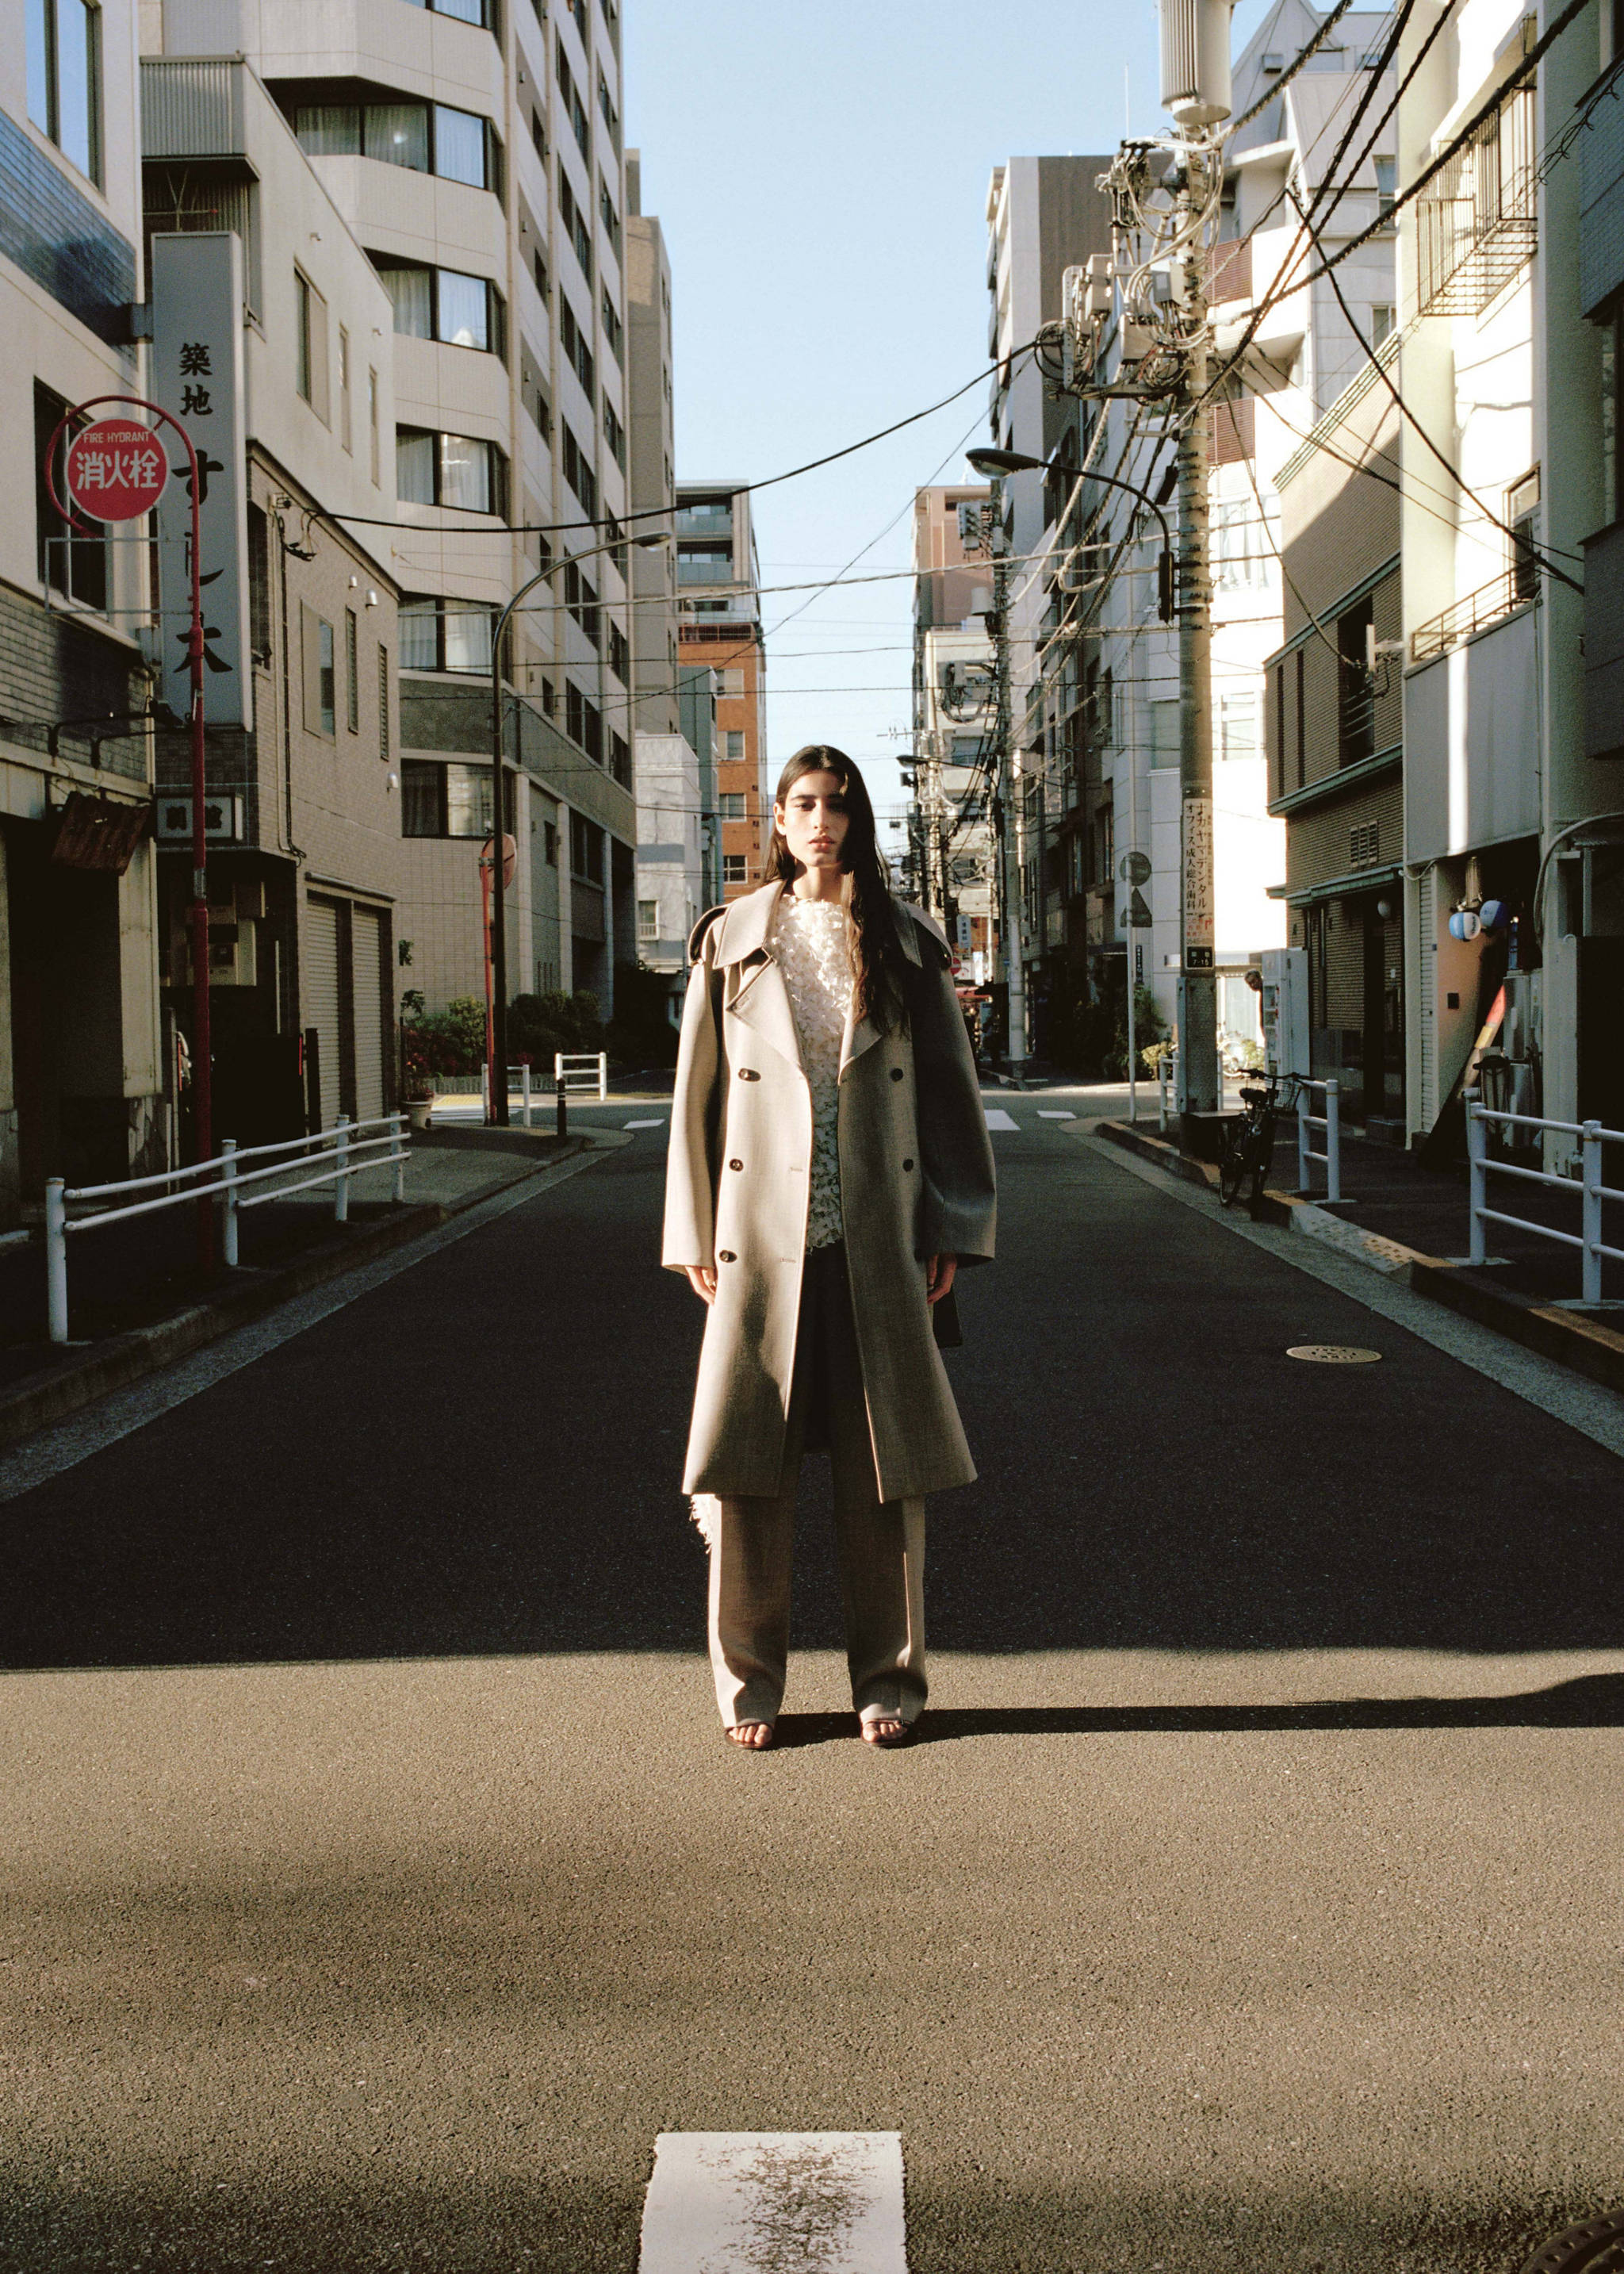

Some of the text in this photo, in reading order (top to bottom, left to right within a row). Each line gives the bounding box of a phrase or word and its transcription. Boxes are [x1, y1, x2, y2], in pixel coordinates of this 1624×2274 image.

[179, 343, 213, 416] 築地
[76, 449, 159, 491] 消火栓
[83, 431, 150, 443] FIRE HYDRANT
[1185, 803, 1196, 911] オフィス成人総合歯科
[1196, 802, 1207, 909] ナカヤマデンタル
